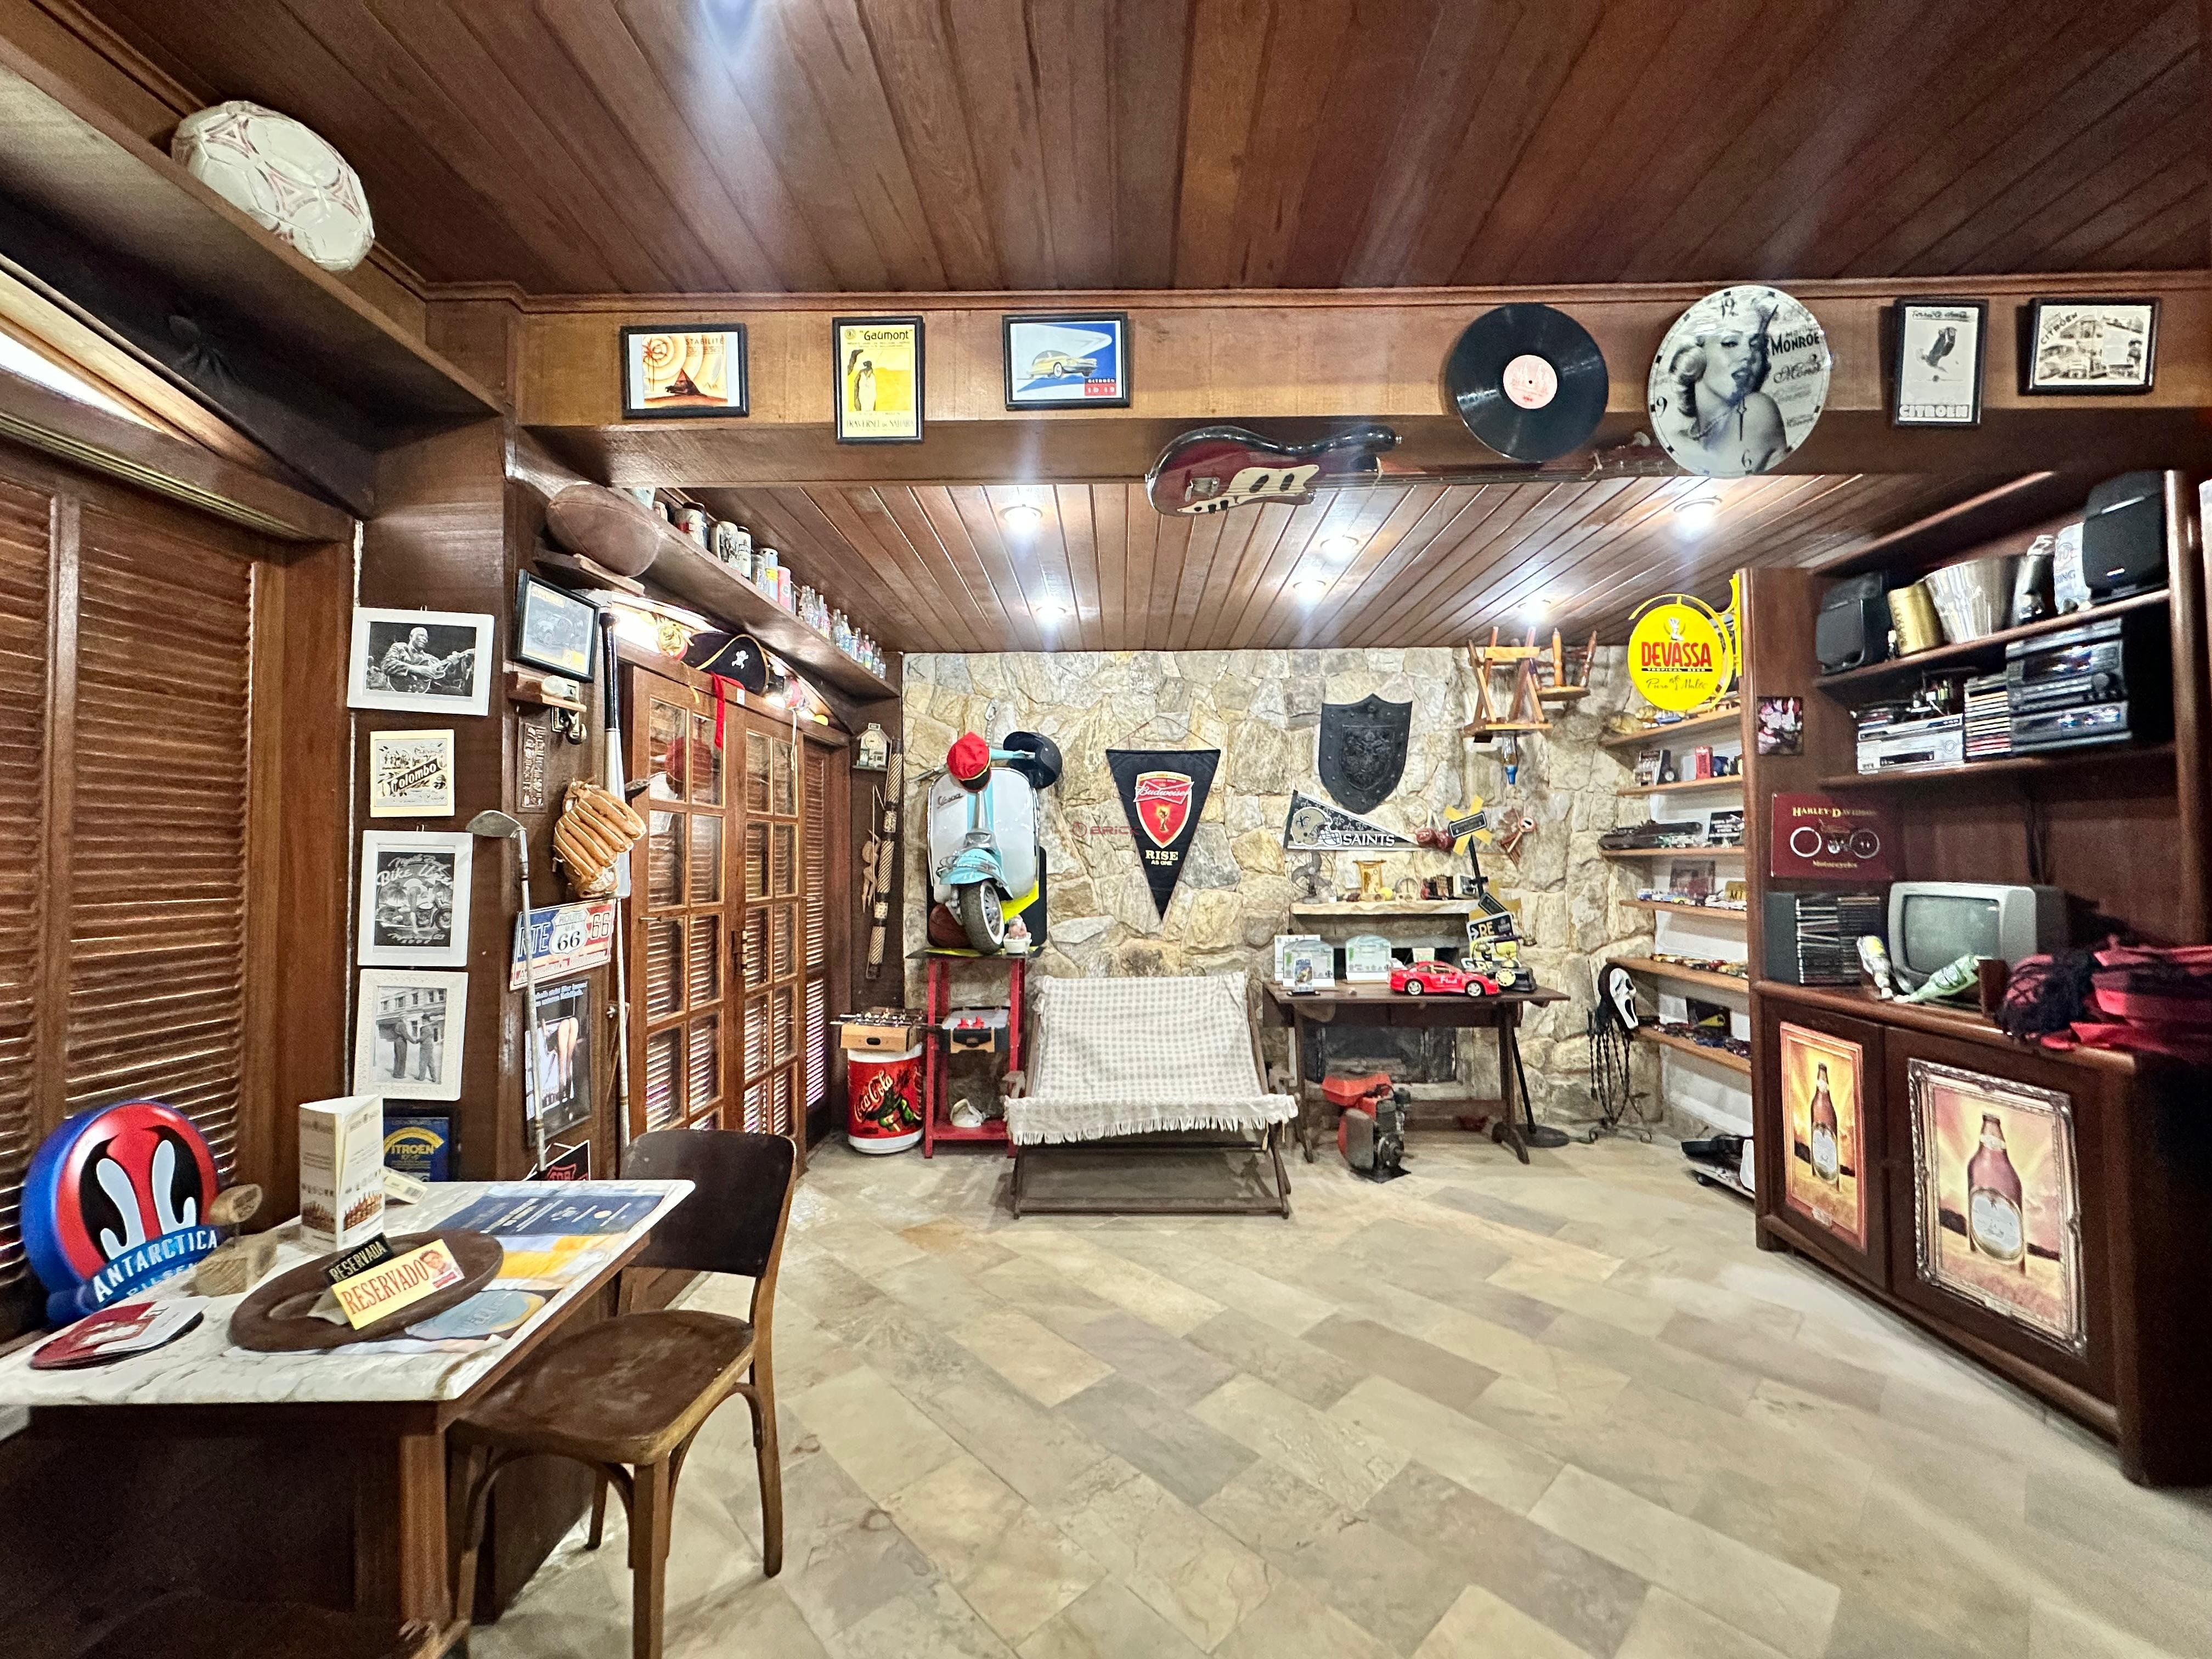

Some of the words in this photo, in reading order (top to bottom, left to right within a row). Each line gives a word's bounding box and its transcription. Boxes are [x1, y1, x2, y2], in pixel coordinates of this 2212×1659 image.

[1722, 298, 1740, 319] 12
[1770, 333, 1820, 356] MONROE
[1656, 396, 1668, 418] 9
[1741, 449, 1752, 468] 6
[1641, 642, 1712, 667] DEVASSA
[391, 763, 437, 793] Colombo
[1135, 786, 1190, 797] Budweiser
[1343, 833, 1395, 847] SAINTS
[1146, 850, 1178, 861] RISE
[376, 867, 413, 887] Bike
[591, 912, 611, 939] 66
[557, 930, 580, 951] 66
[93, 1229, 218, 1303] ANTARCTICA
[329, 1240, 387, 1283] RESERVADA
[340, 1259, 429, 1315] RESERVADO
